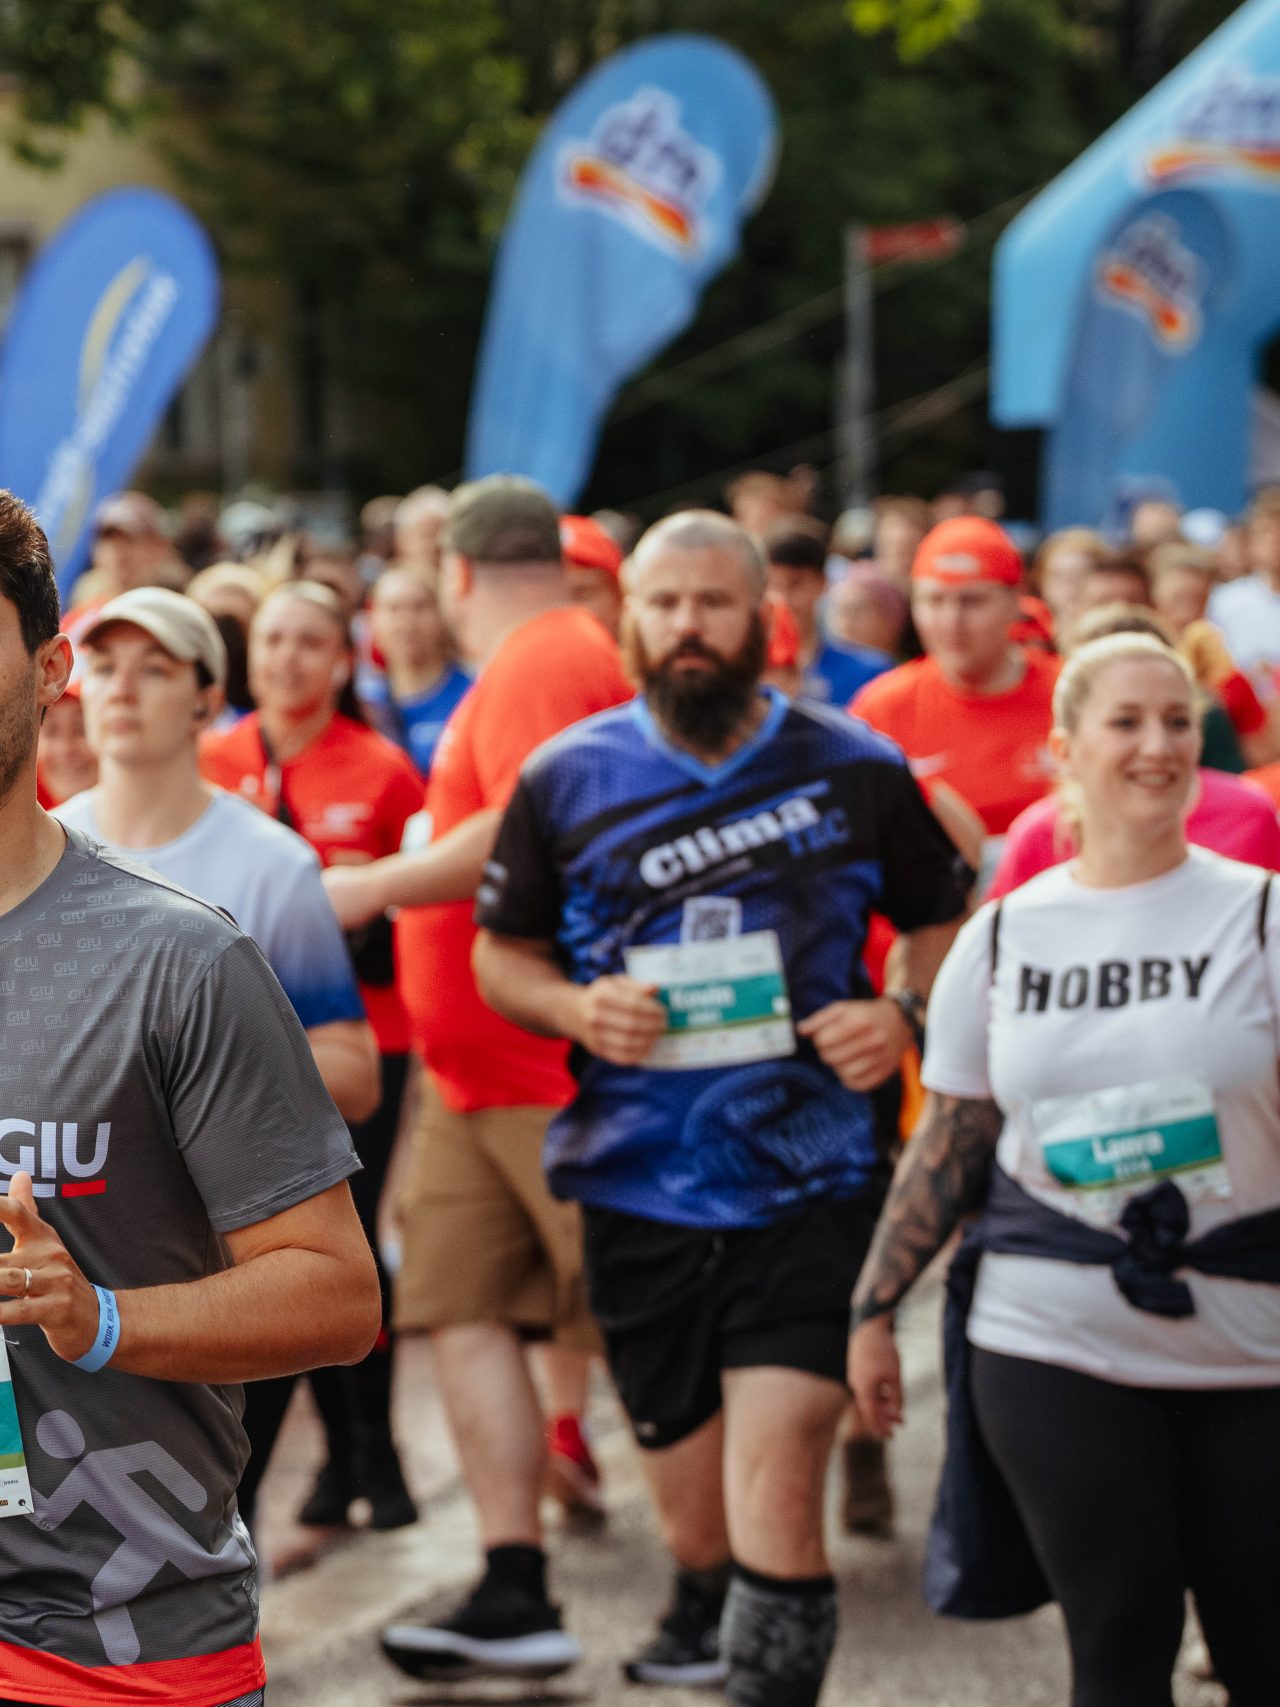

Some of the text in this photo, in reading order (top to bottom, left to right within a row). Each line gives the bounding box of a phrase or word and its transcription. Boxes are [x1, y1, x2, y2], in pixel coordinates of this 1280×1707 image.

[640, 797, 819, 888] Clima
[1017, 954, 1211, 1013] HOBBY
[106, 1307, 114, 1323] RUN
[102, 1324, 114, 1348] WORK
